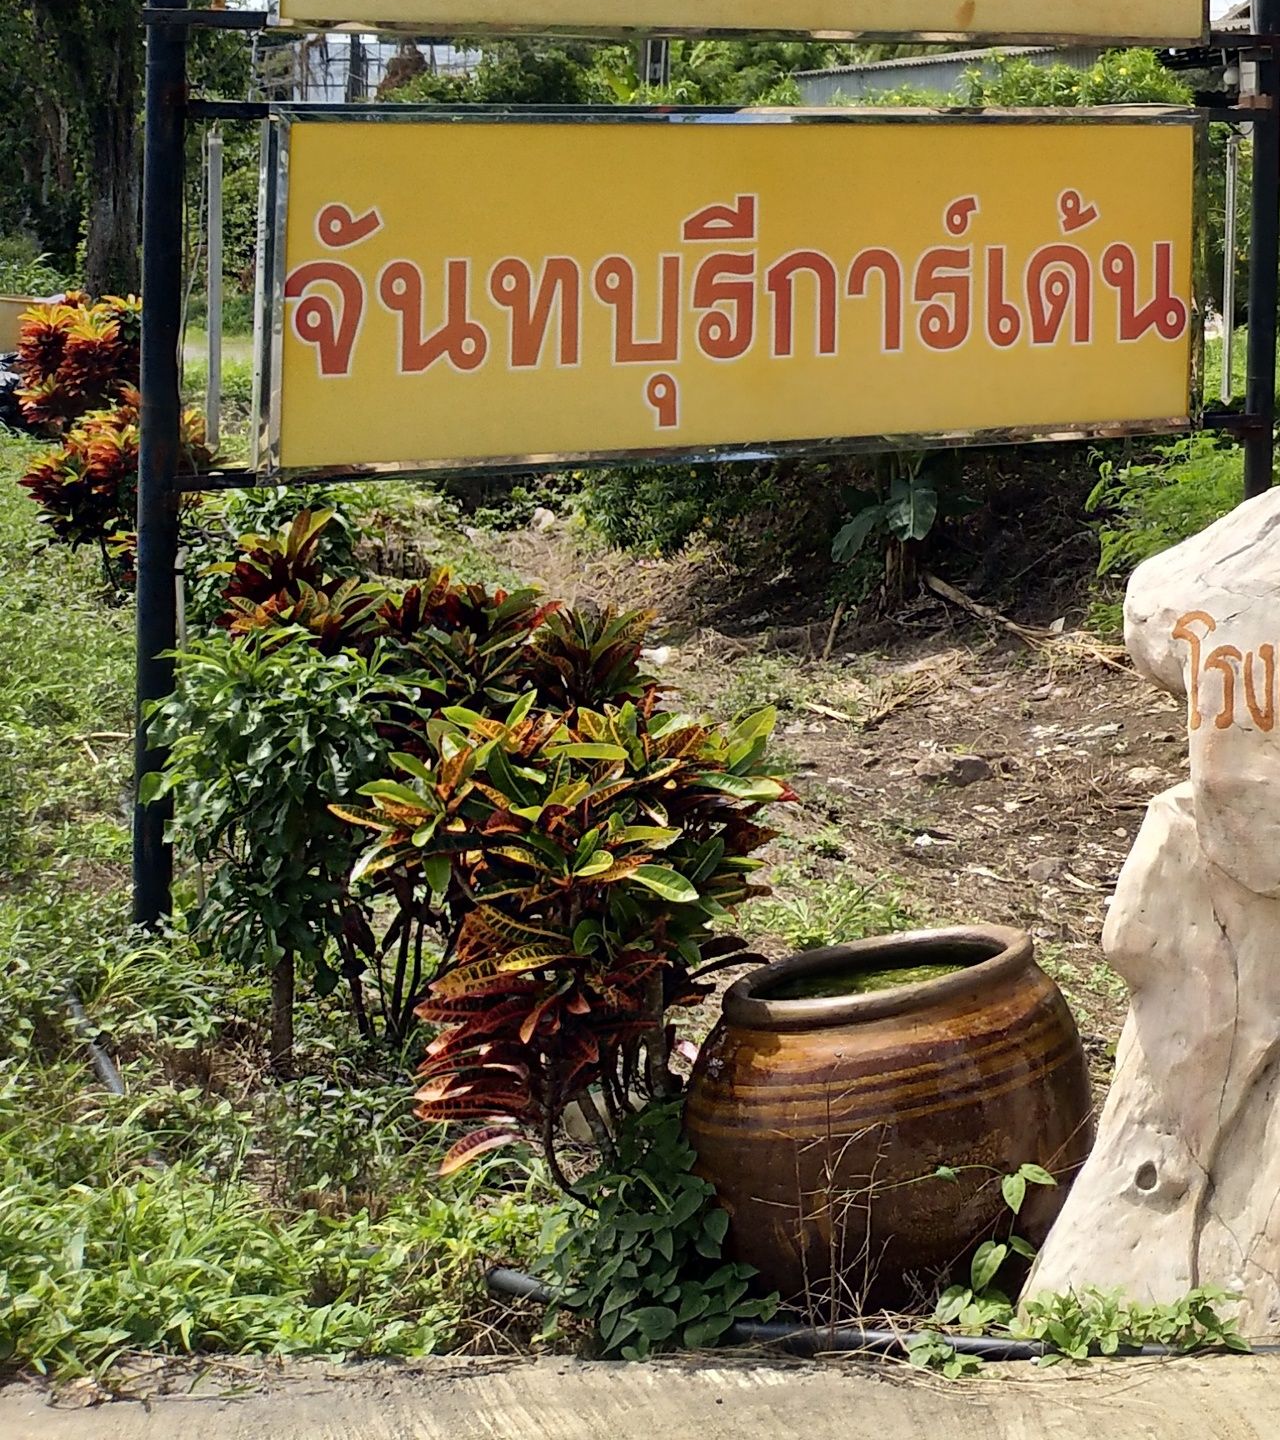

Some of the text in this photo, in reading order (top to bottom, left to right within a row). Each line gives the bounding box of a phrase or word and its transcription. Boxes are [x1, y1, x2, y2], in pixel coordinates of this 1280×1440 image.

[285, 192, 1187, 428] จันทบุรีการ์เด้น
